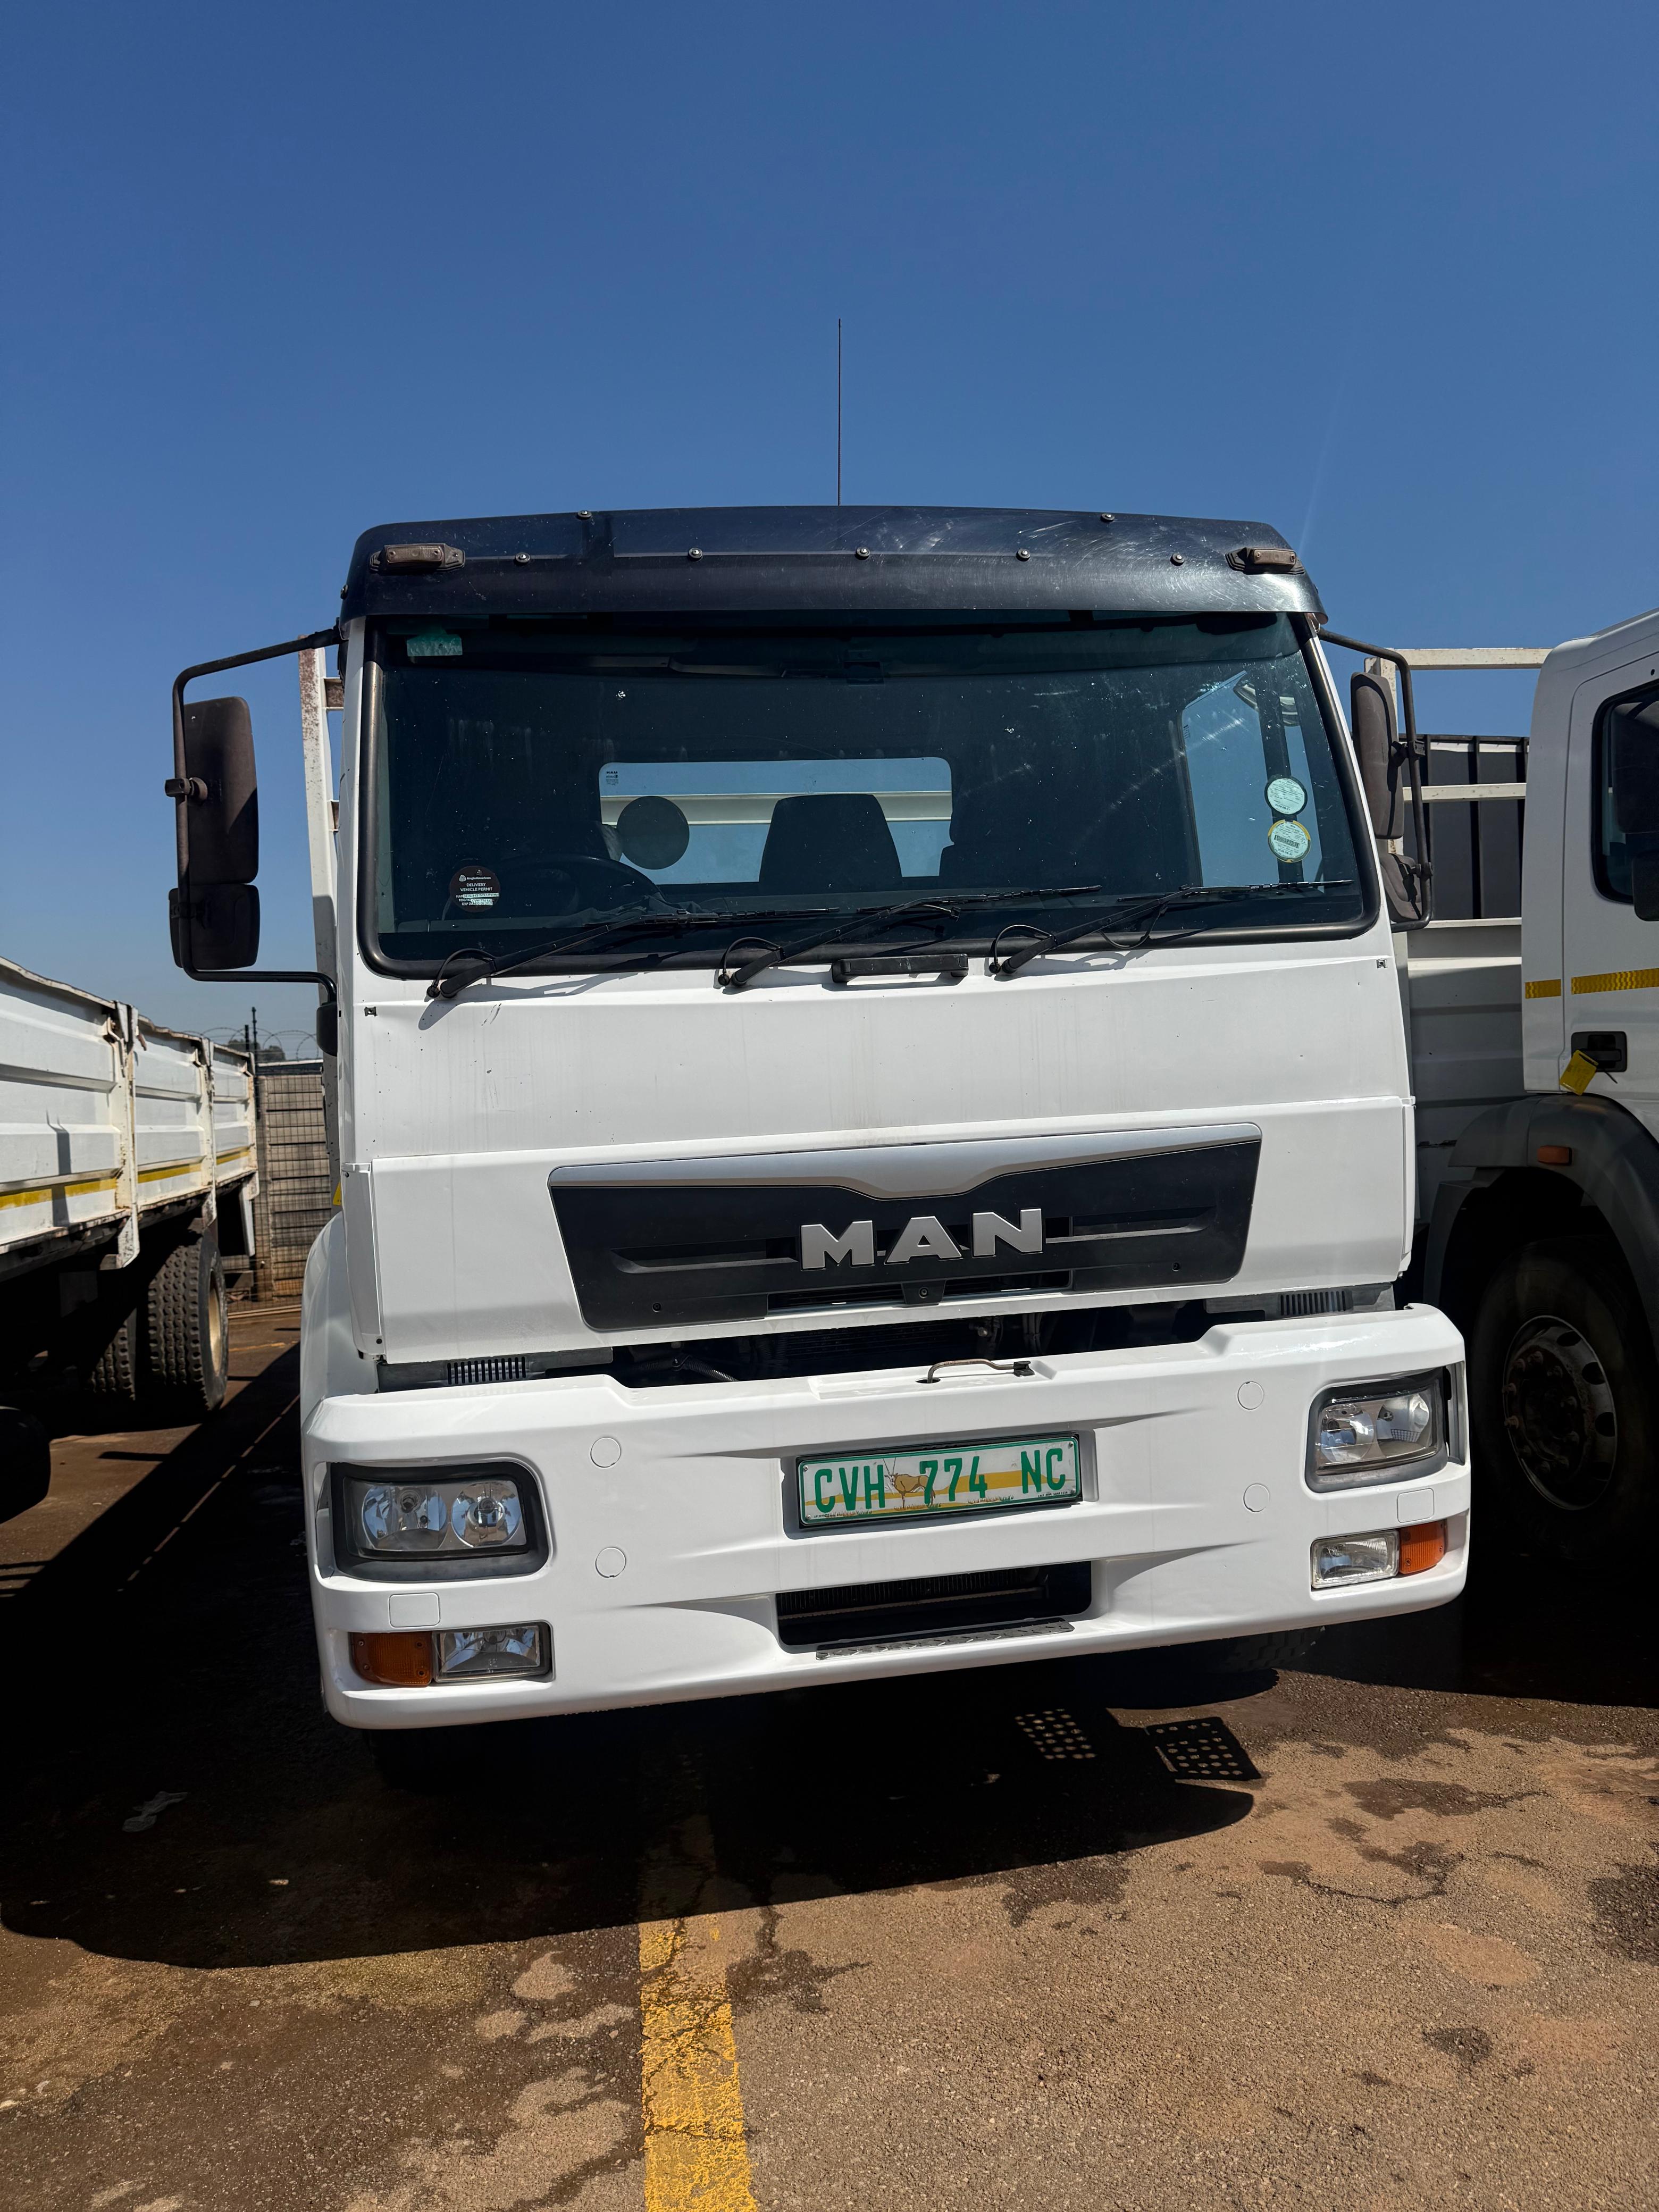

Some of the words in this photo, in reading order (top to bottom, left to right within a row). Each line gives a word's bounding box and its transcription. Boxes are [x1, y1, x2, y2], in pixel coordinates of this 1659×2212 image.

[801, 1208, 1043, 1269] MAN
[814, 1464, 886, 1513] CVH
[919, 1455, 988, 1505] 774
[1020, 1447, 1066, 1494] NC
